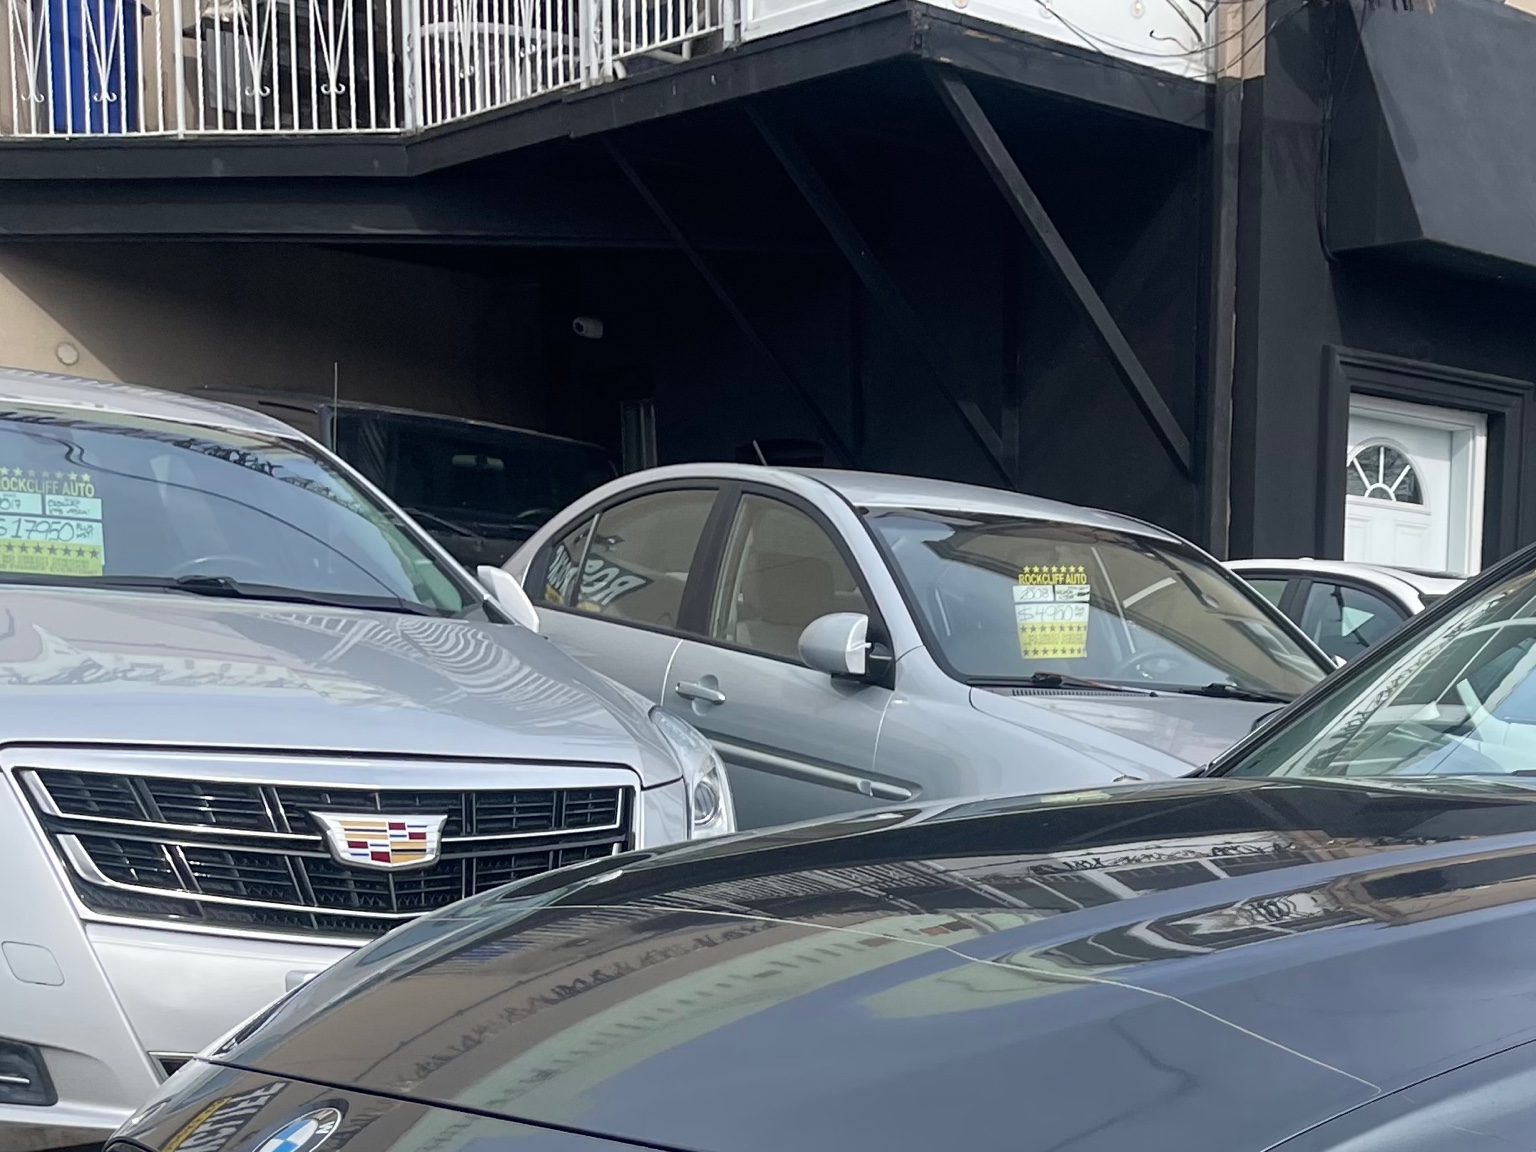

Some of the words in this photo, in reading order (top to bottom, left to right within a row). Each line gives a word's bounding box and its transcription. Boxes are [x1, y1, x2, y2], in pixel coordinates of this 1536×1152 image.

[0, 476, 59, 495] OCKCLIFF
[62, 482, 95, 497] AUTO
[1018, 573, 1064, 585] ROCKCLIFF
[1065, 573, 1087, 585] AUTO
